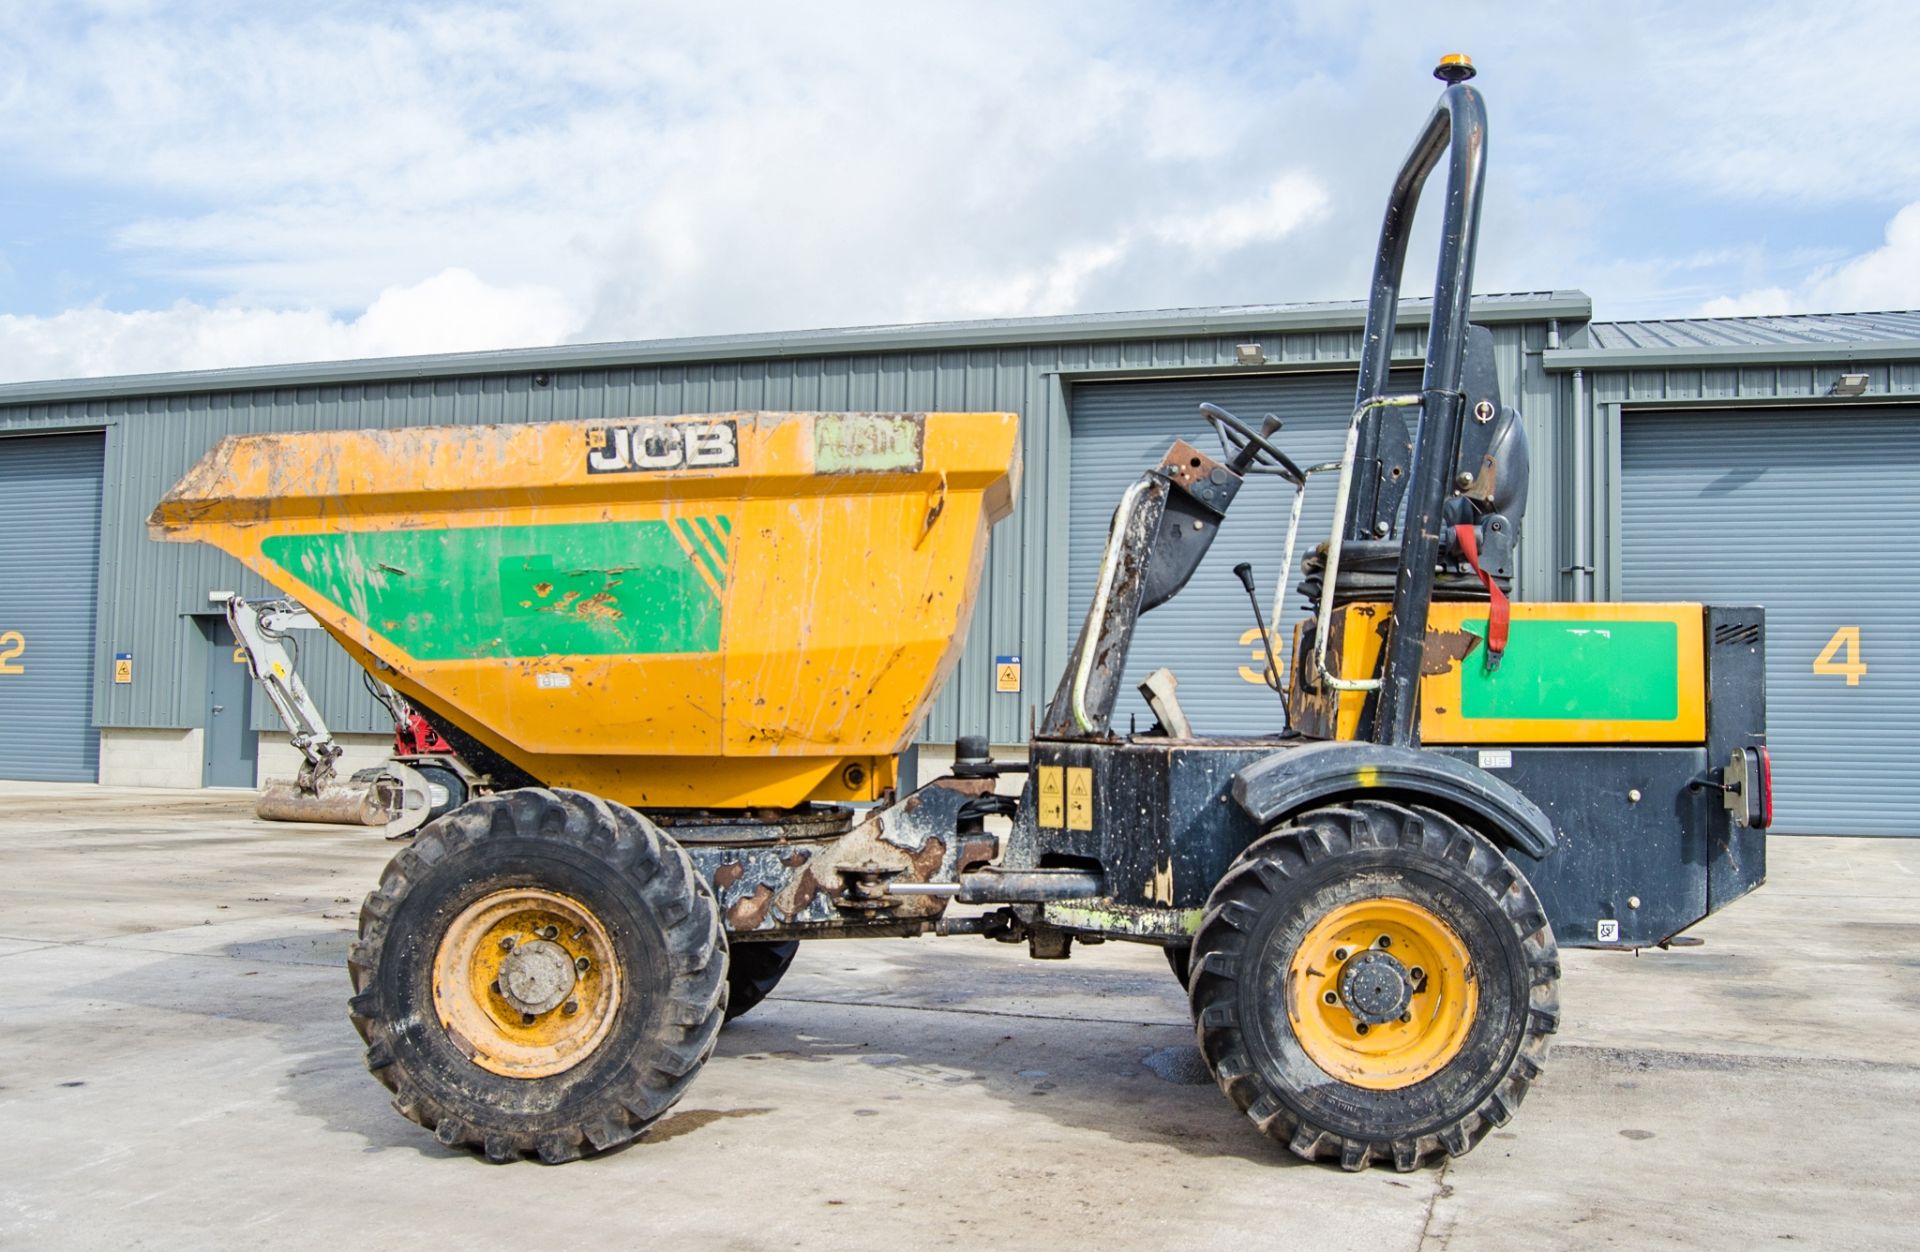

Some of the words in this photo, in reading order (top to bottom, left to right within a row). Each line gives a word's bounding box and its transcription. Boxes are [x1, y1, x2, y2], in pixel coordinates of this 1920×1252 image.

[589, 424, 736, 470] JCB
[0, 631, 25, 674] 2
[1238, 628, 1284, 684] 3
[1813, 626, 1867, 686] 4
